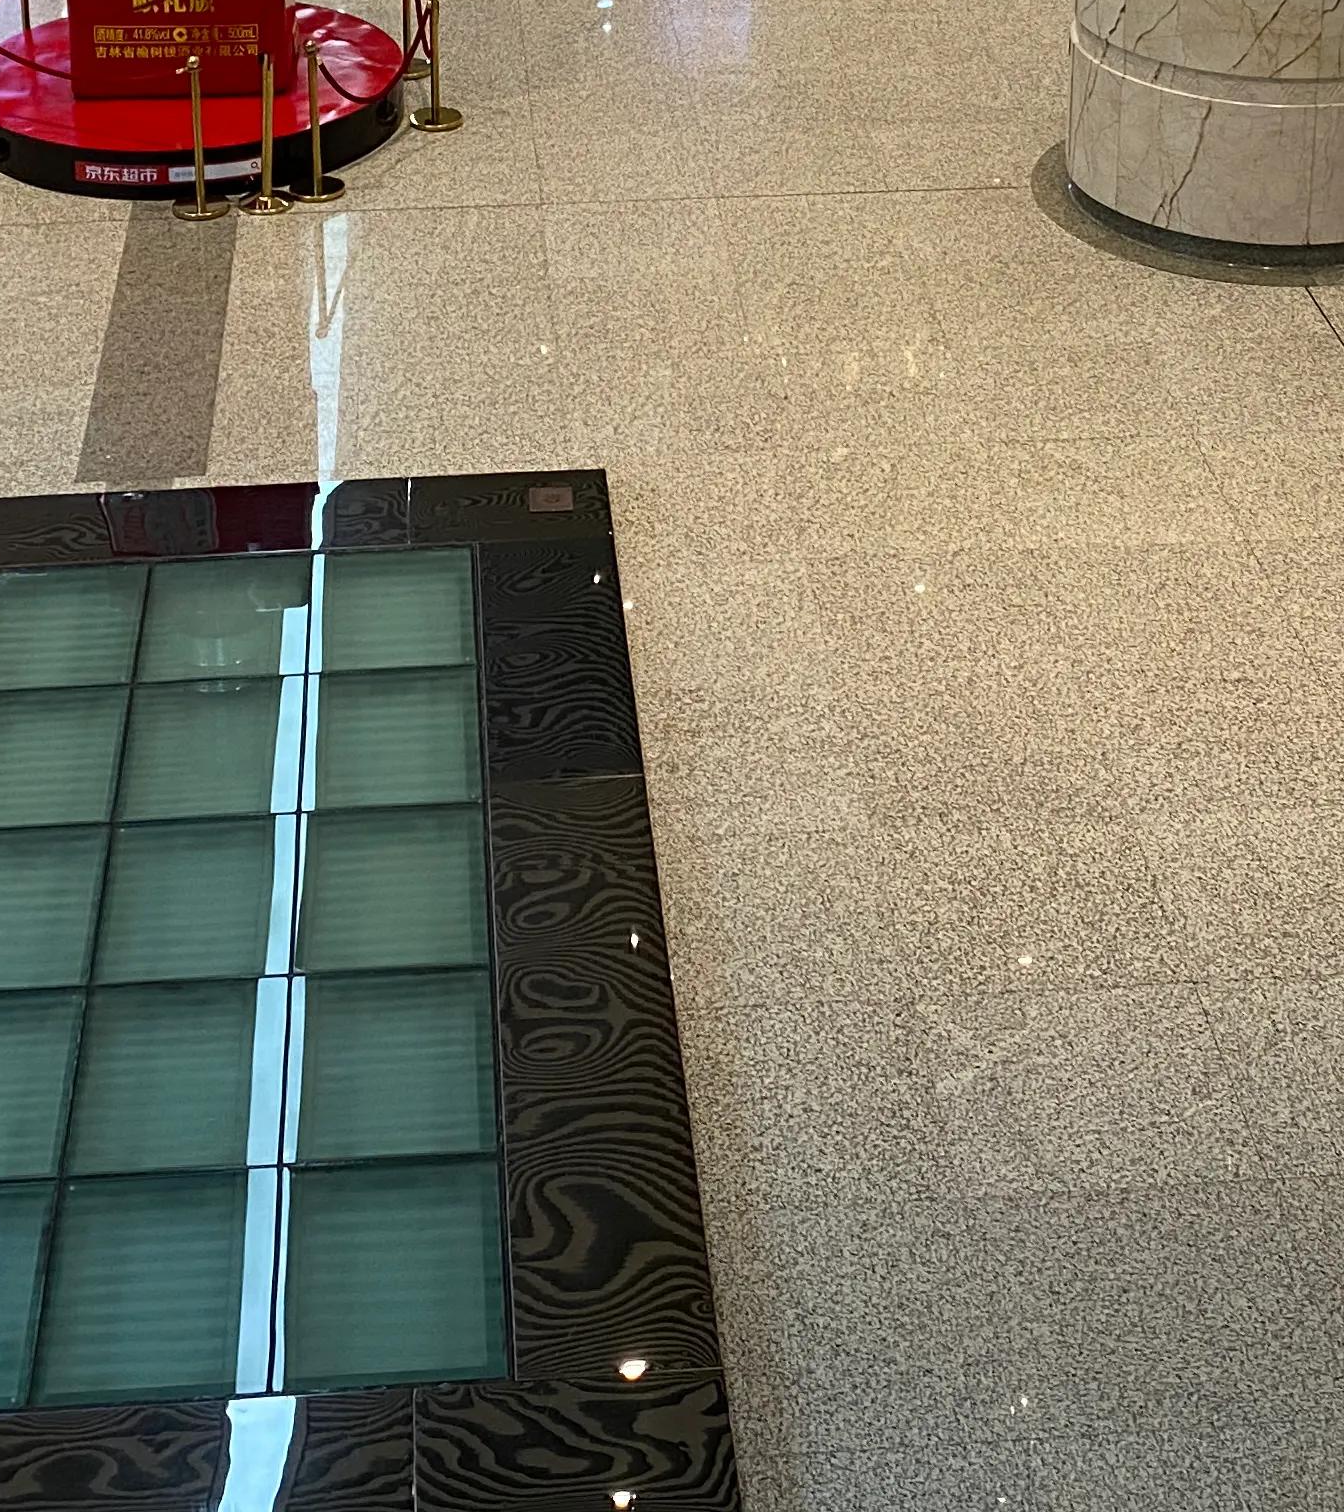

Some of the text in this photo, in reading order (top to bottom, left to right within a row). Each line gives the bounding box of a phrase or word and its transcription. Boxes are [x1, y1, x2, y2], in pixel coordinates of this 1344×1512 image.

[228, 25, 256, 38] 500mL
[85, 165, 157, 183] 京东超市
